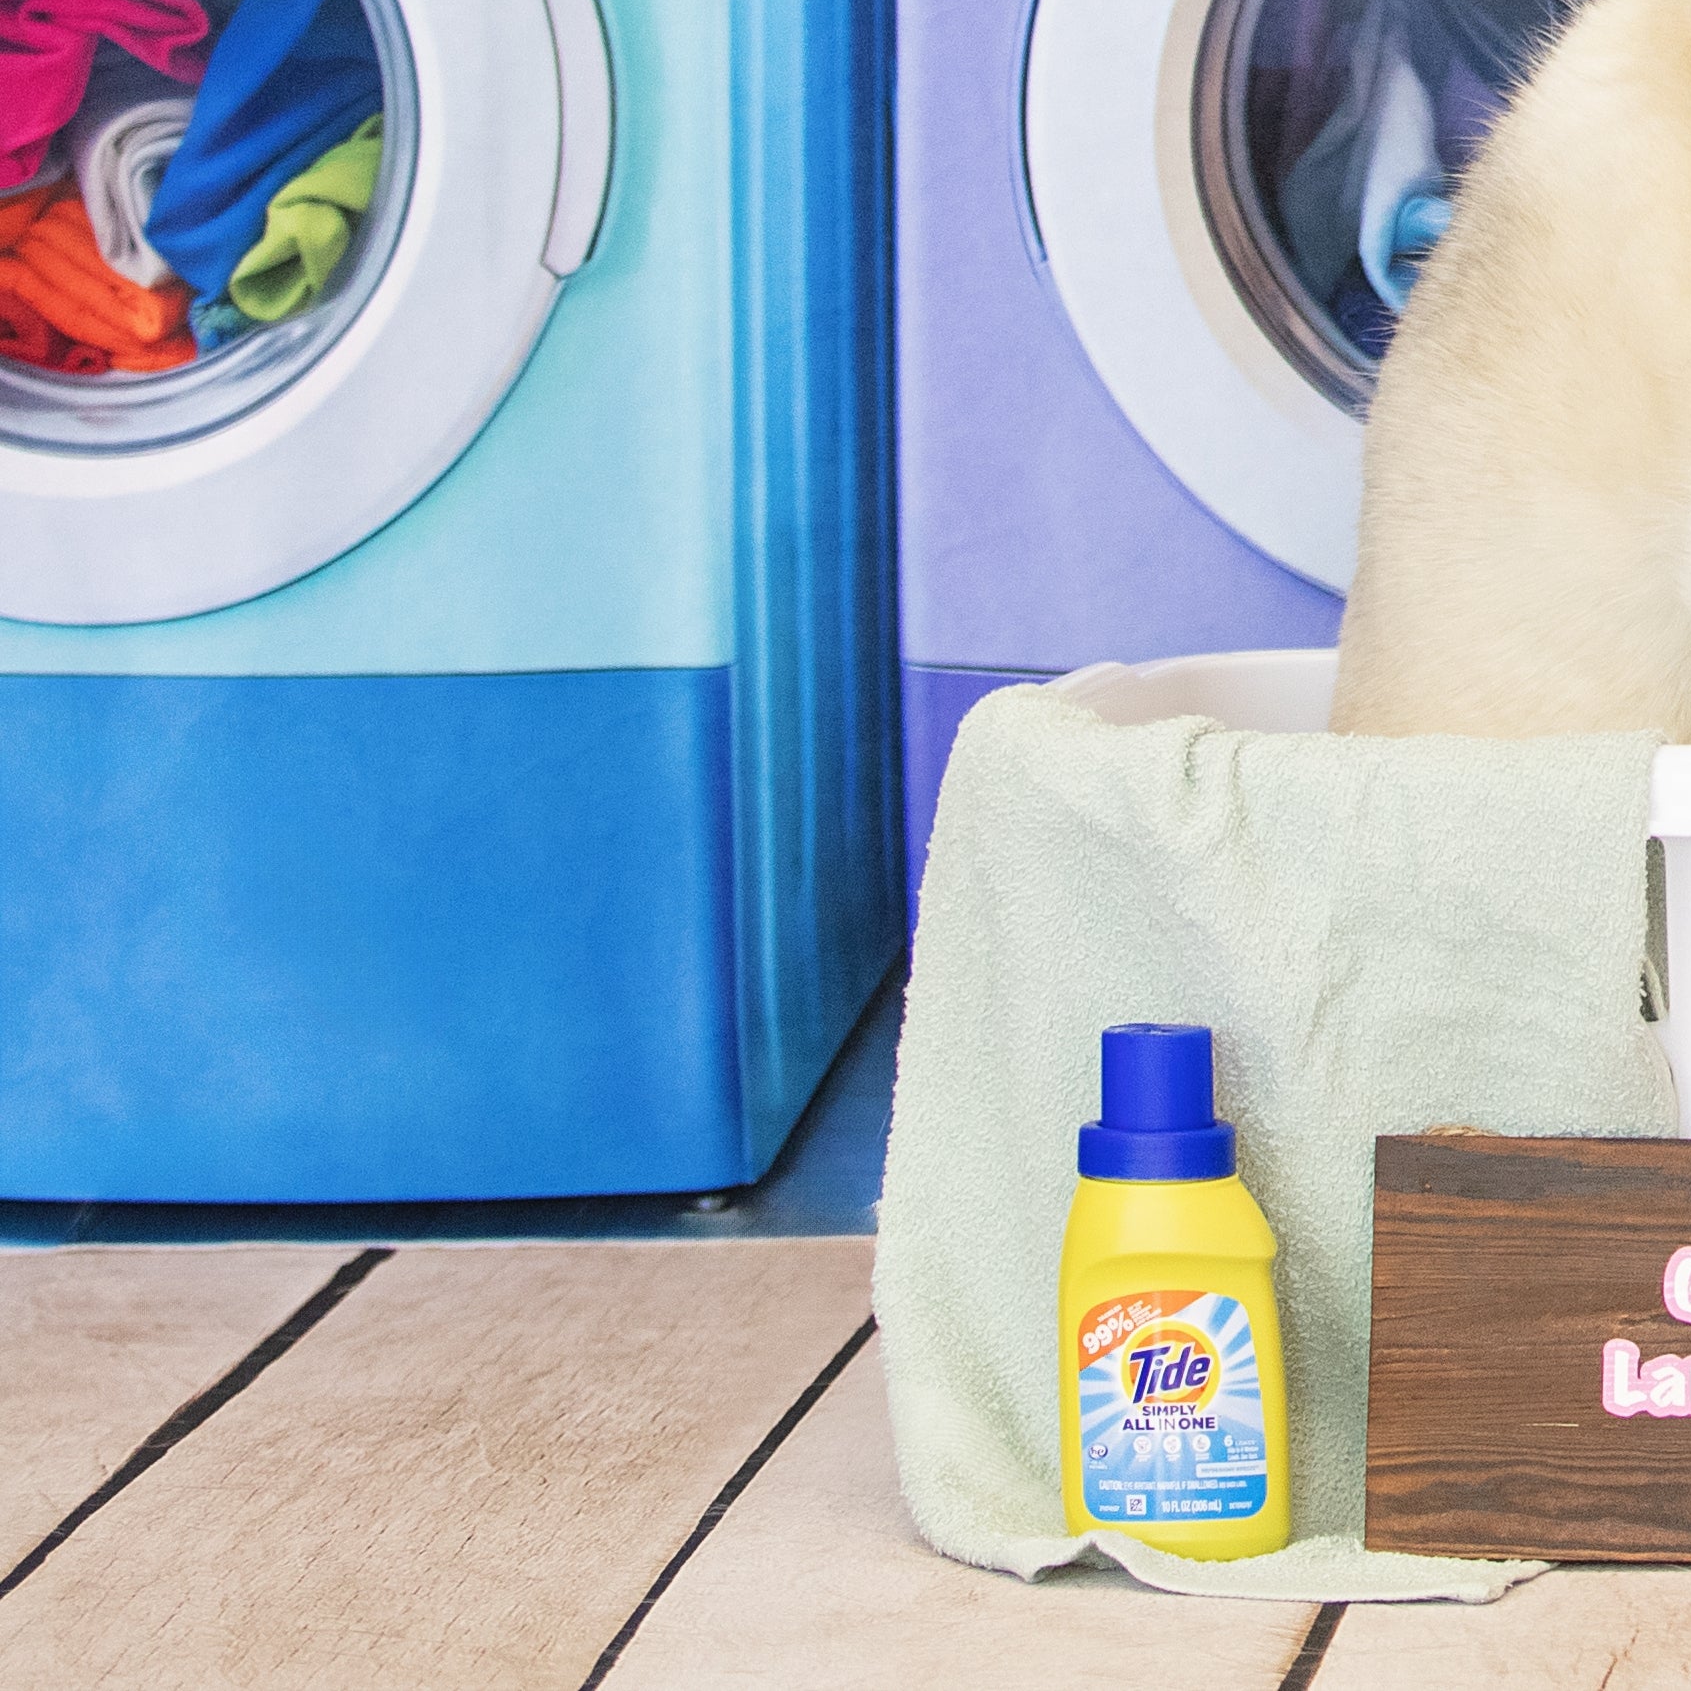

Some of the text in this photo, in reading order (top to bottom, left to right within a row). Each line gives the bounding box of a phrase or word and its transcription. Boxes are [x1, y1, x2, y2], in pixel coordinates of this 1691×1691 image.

[1082, 1311, 1135, 1355] 99%
[1129, 1346, 1211, 1404] Tide
[1142, 1405, 1197, 1416] SIMPLY
[1122, 1417, 1216, 1431] ALL IN ONE
[1223, 1434, 1233, 1447] 6
[1161, 1501, 1171, 1513] 10
